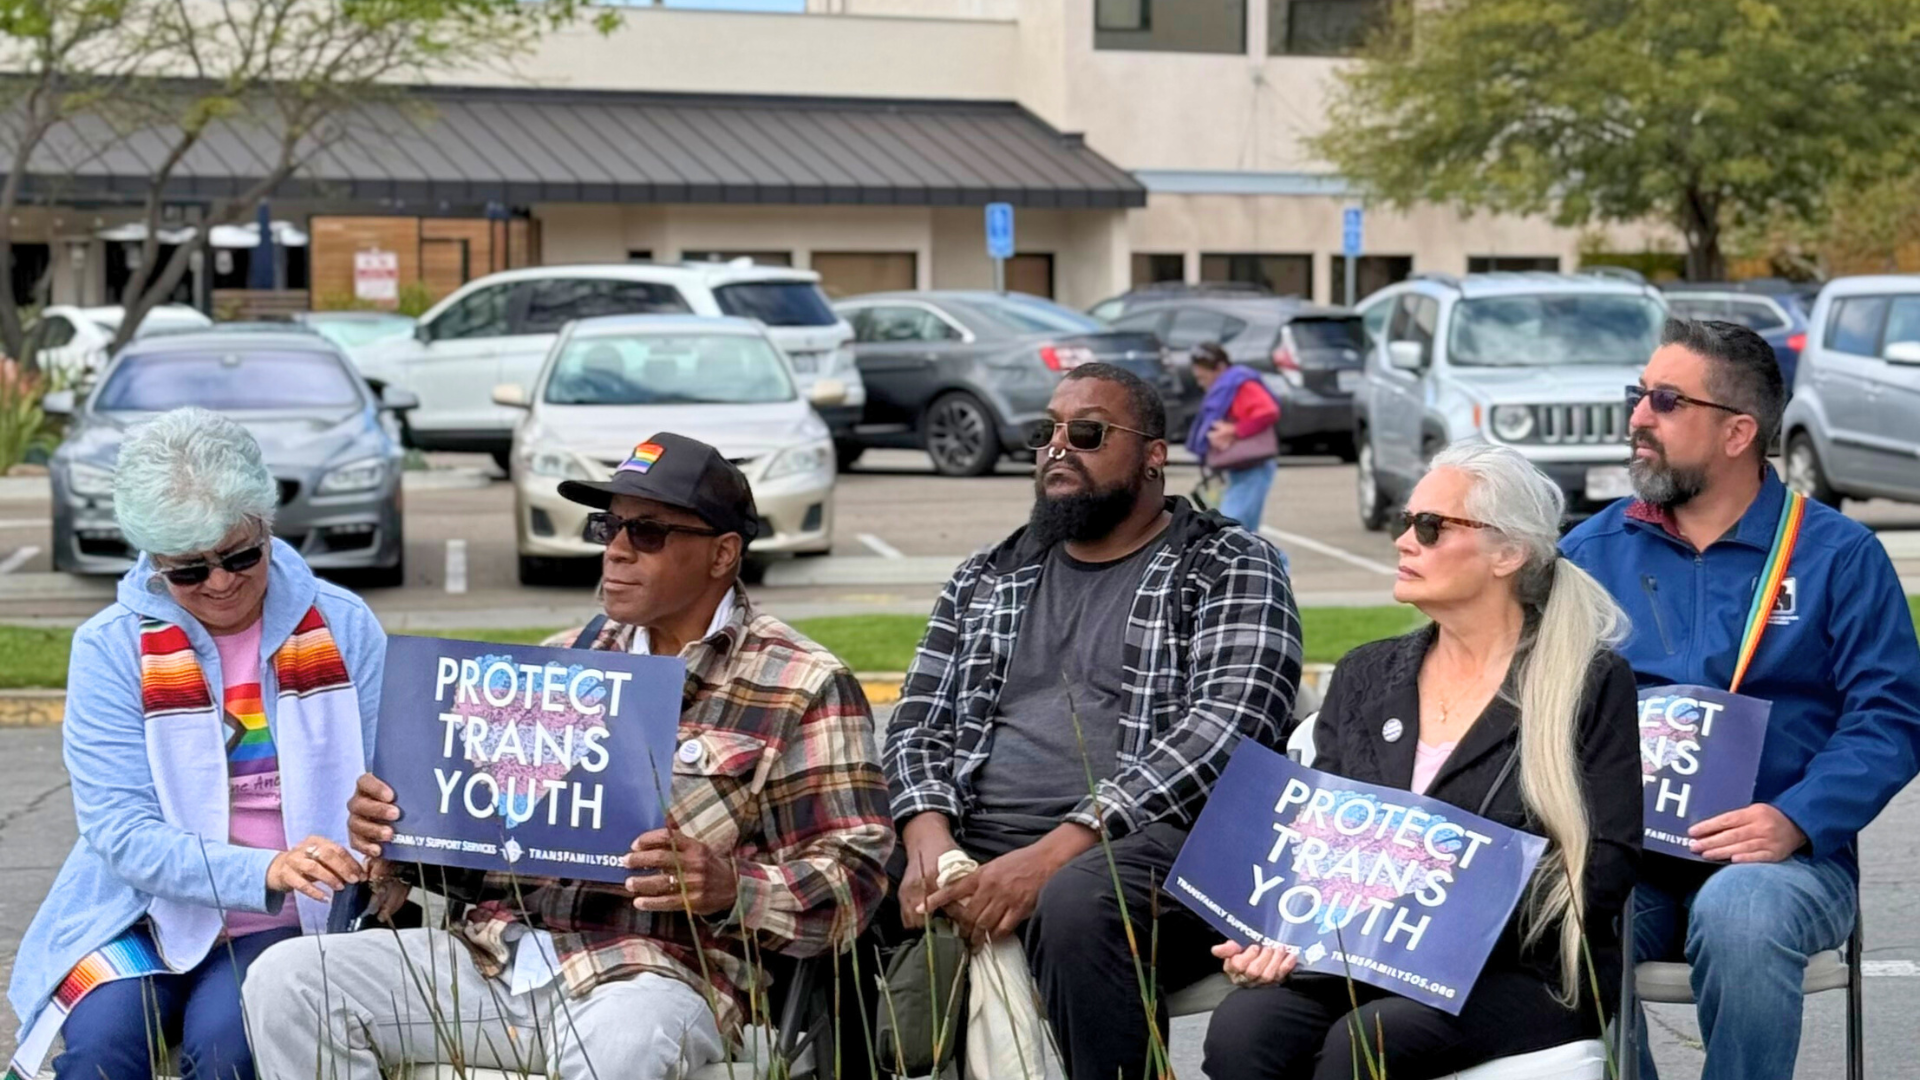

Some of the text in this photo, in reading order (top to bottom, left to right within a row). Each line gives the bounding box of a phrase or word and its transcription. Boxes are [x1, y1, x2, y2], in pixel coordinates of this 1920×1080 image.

[435, 656, 632, 717] PROTECT
[1637, 697, 1724, 737] ECT
[438, 713, 611, 773] TRANS
[434, 768, 604, 829] YOUTH
[1274, 778, 1492, 869] PROTECT
[425, 836, 461, 851] SUPPORT
[462, 840, 498, 855] SERVICES
[1267, 822, 1454, 907] TRANS
[1177, 876, 1228, 918] TRANSFAMILY
[1226, 914, 1263, 942] SUPPORT
[1248, 863, 1432, 951] YOUTH
[1331, 950, 1456, 998] TRANSFAMILYSOS.ORG
